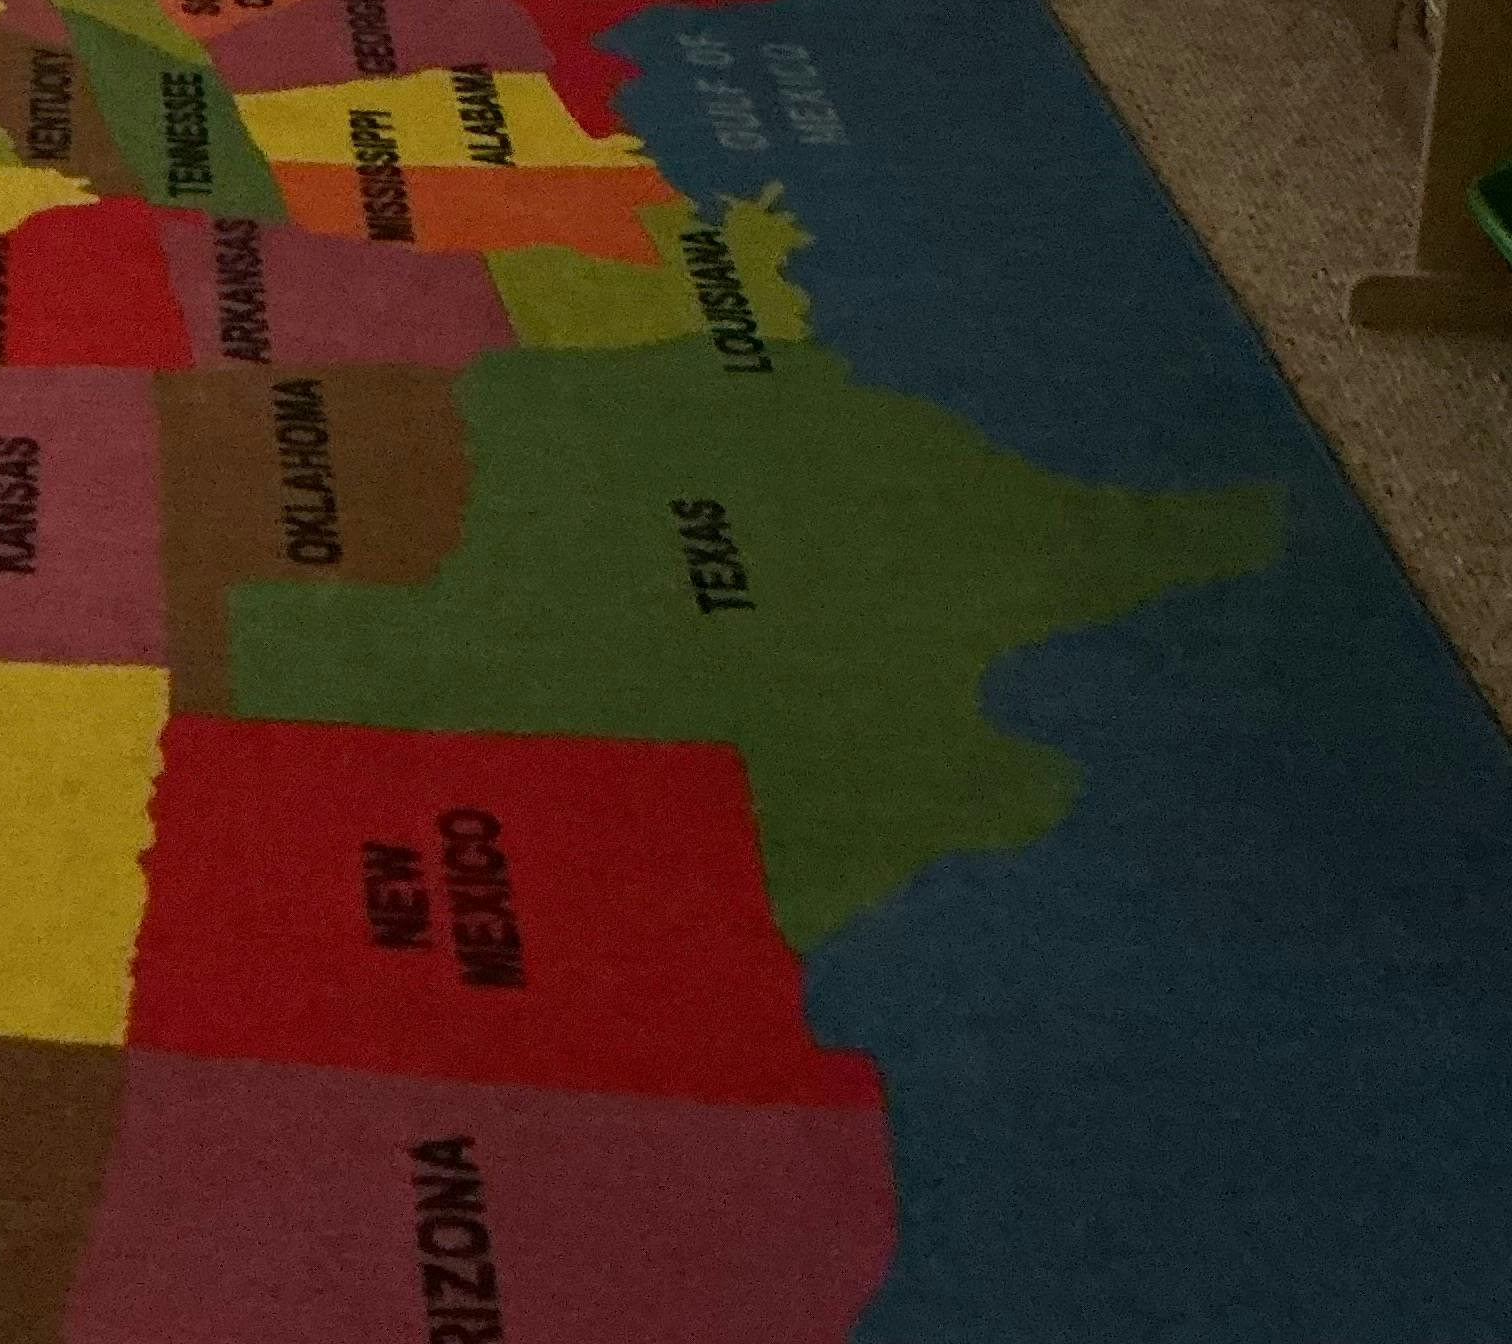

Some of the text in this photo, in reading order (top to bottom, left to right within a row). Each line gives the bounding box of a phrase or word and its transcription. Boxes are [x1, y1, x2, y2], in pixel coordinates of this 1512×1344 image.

[26, 47, 74, 161] KENTUCKY
[161, 71, 213, 199] TENNESSEE
[451, 62, 516, 168] ALABAMA
[349, 109, 416, 243] MISSISSIPPI
[213, 217, 272, 364] ARKANSAS
[680, 221, 774, 374] LOUISIANA
[271, 377, 345, 568] OKLAHOMA
[668, 496, 759, 616] TEXAS
[361, 840, 436, 953] NEW
[436, 807, 528, 992] MEXICO
[408, 1133, 506, 1344] RIZONA
